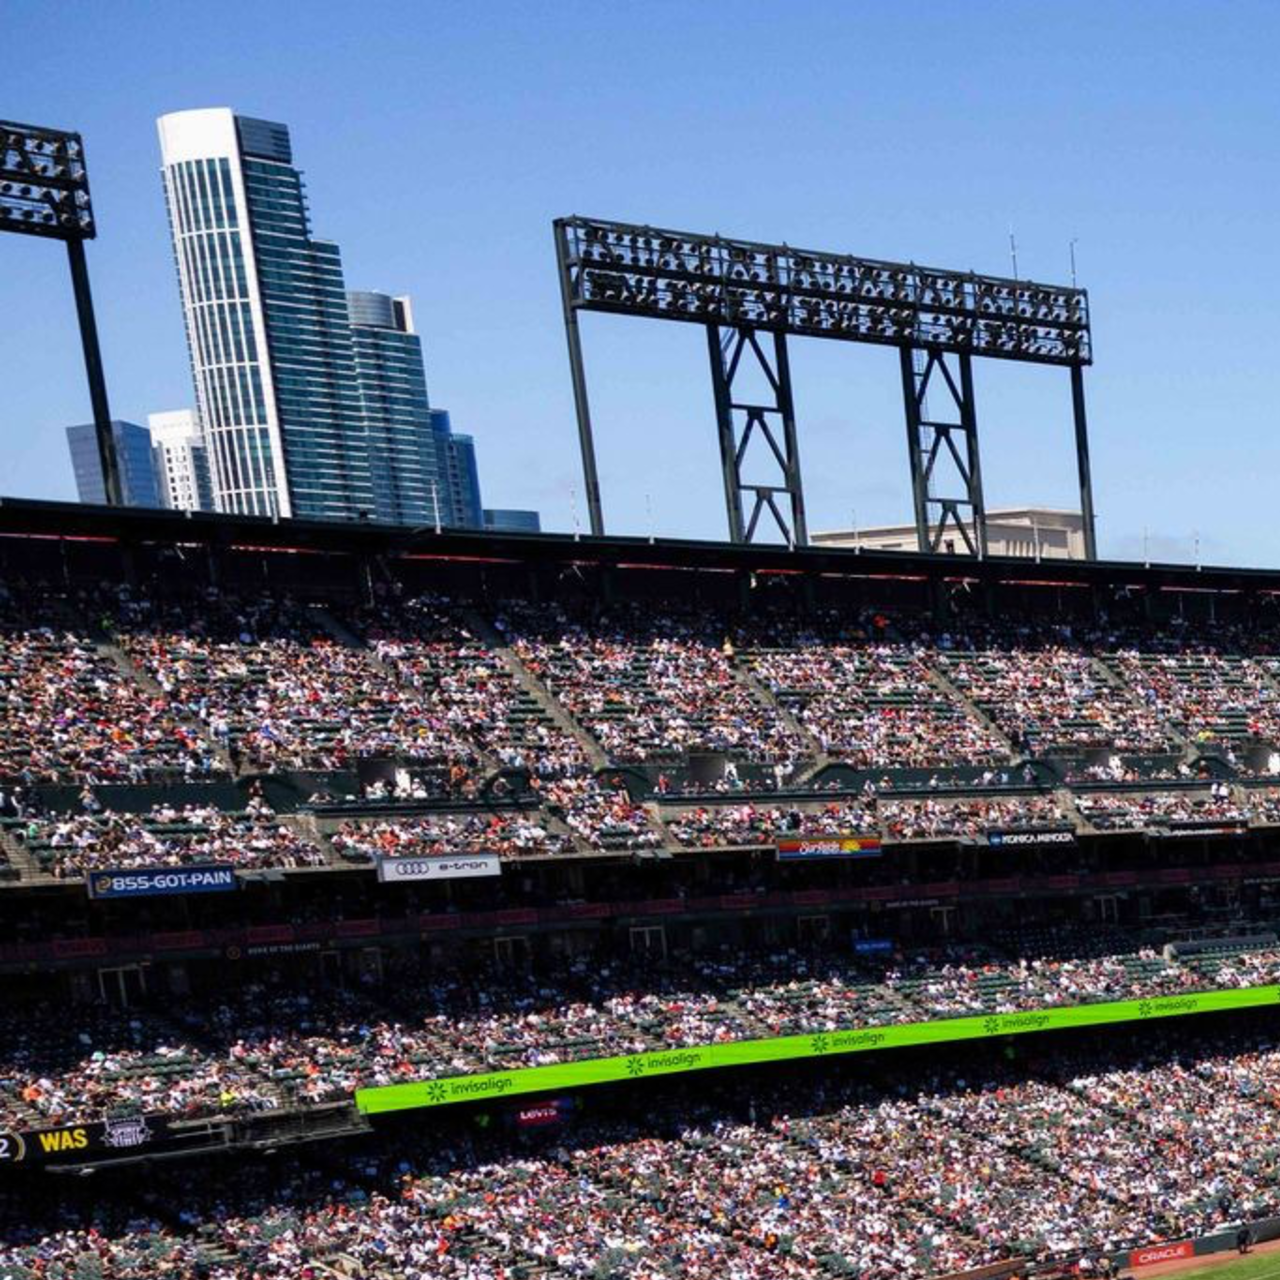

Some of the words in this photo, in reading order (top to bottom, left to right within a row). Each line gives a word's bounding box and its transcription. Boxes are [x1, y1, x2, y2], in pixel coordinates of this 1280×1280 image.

[438, 861, 489, 871] e-tron
[112, 871, 232, 891] 855-GOT-PAIN
[1155, 998, 1198, 1011] invisalign
[1002, 1015, 1050, 1028] invisalign
[831, 1032, 885, 1048] invisalign
[647, 1053, 701, 1069] invisalign
[450, 1077, 513, 1095] invisalign
[39, 1128, 89, 1153] WAS
[1138, 1245, 1186, 1264] ORACLE
